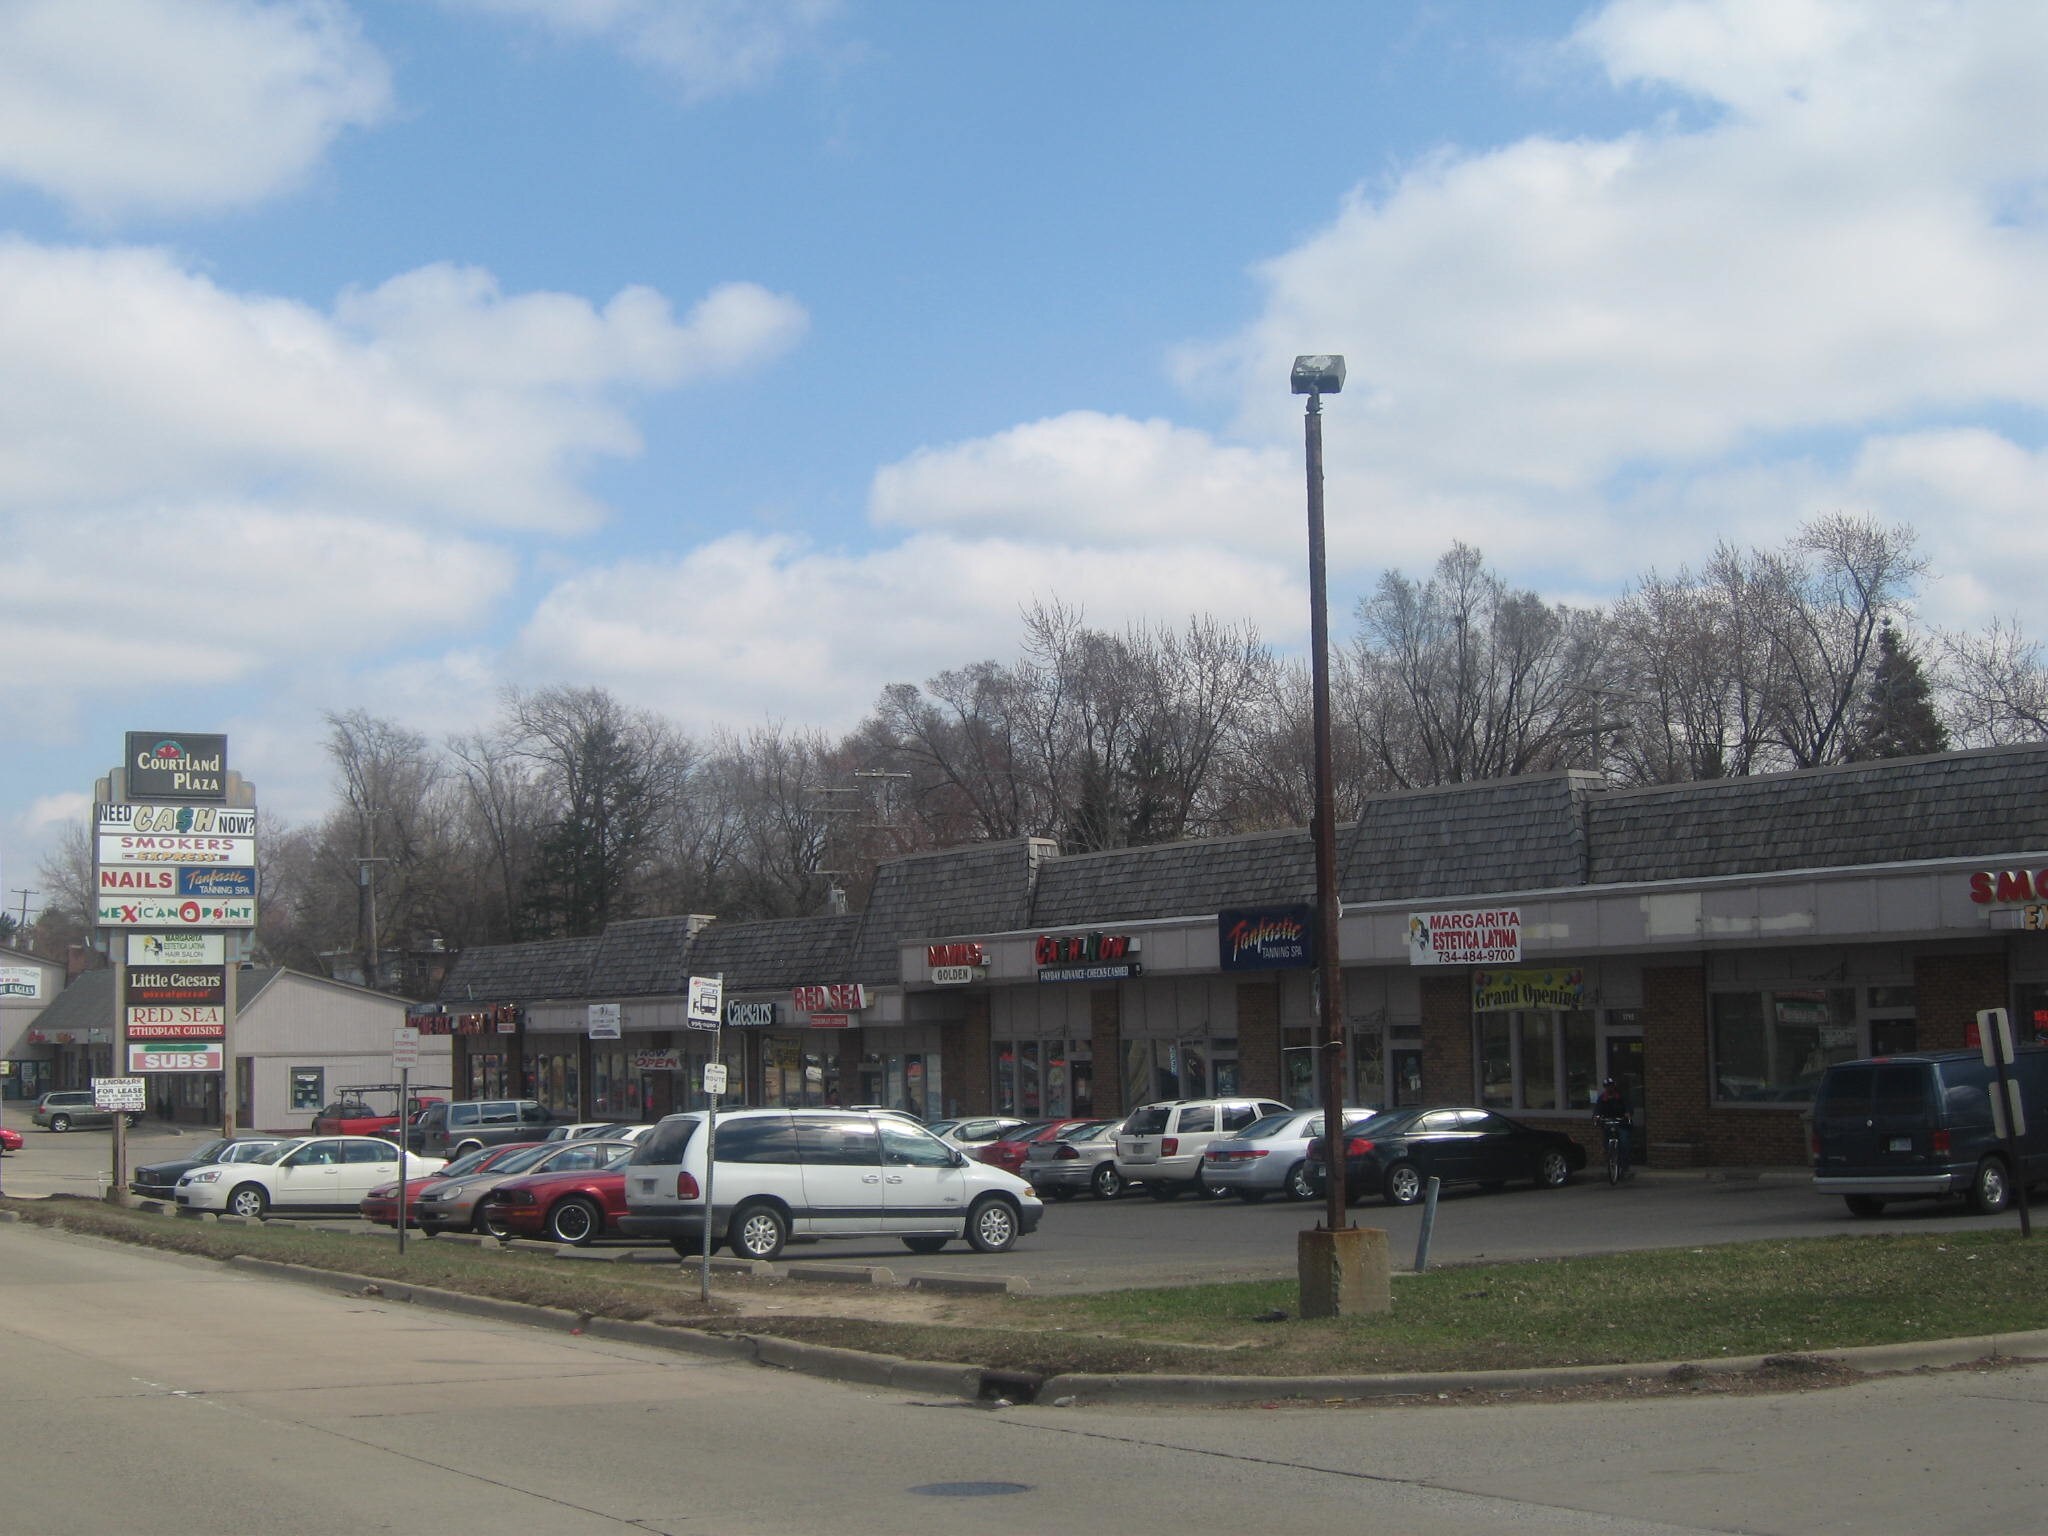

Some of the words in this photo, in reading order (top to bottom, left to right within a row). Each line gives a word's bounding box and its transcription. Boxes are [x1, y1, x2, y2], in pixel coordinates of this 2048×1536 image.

[100, 805, 132, 822] NEED
[219, 816, 255, 834] NOW?
[121, 837, 235, 850] SMOKERS
[138, 852, 218, 862] EXPRESS
[101, 871, 173, 889] NAILS
[200, 885, 233, 895] TANNING
[235, 886, 250, 895] SPA
[1430, 911, 1520, 930] MARGARITA
[1432, 930, 1480, 951] ESTETICA
[1482, 929, 1518, 949] LATINA
[1262, 946, 1291, 959] TANNING
[1291, 945, 1303, 958] SPA
[1437, 949, 1516, 963] 734-484-9700
[131, 973, 168, 988] Little
[171, 973, 221, 988] Caesars
[937, 967, 969, 981] GOLDEN
[1040, 969, 1061, 981] PAYDAY
[1061, 968, 1085, 980] ADVANCE
[1086, 967, 1107, 979] CHECKS
[1107, 966, 1129, 977] CASHED
[793, 985, 828, 1012] RED
[829, 984, 865, 1010] SEA
[1475, 983, 1519, 1009] Grand
[1523, 983, 1580, 1010] Opening
[133, 1007, 174, 1024] RED
[179, 1007, 218, 1022] SEA
[727, 1000, 772, 1026] Caesars
[130, 1026, 181, 1036] ETHIOPIAN
[183, 1026, 222, 1035] CUISINE
[144, 1053, 208, 1069] SUBS
[634, 1056, 677, 1068] OPEN
[706, 1075, 725, 1083] ROUTE
